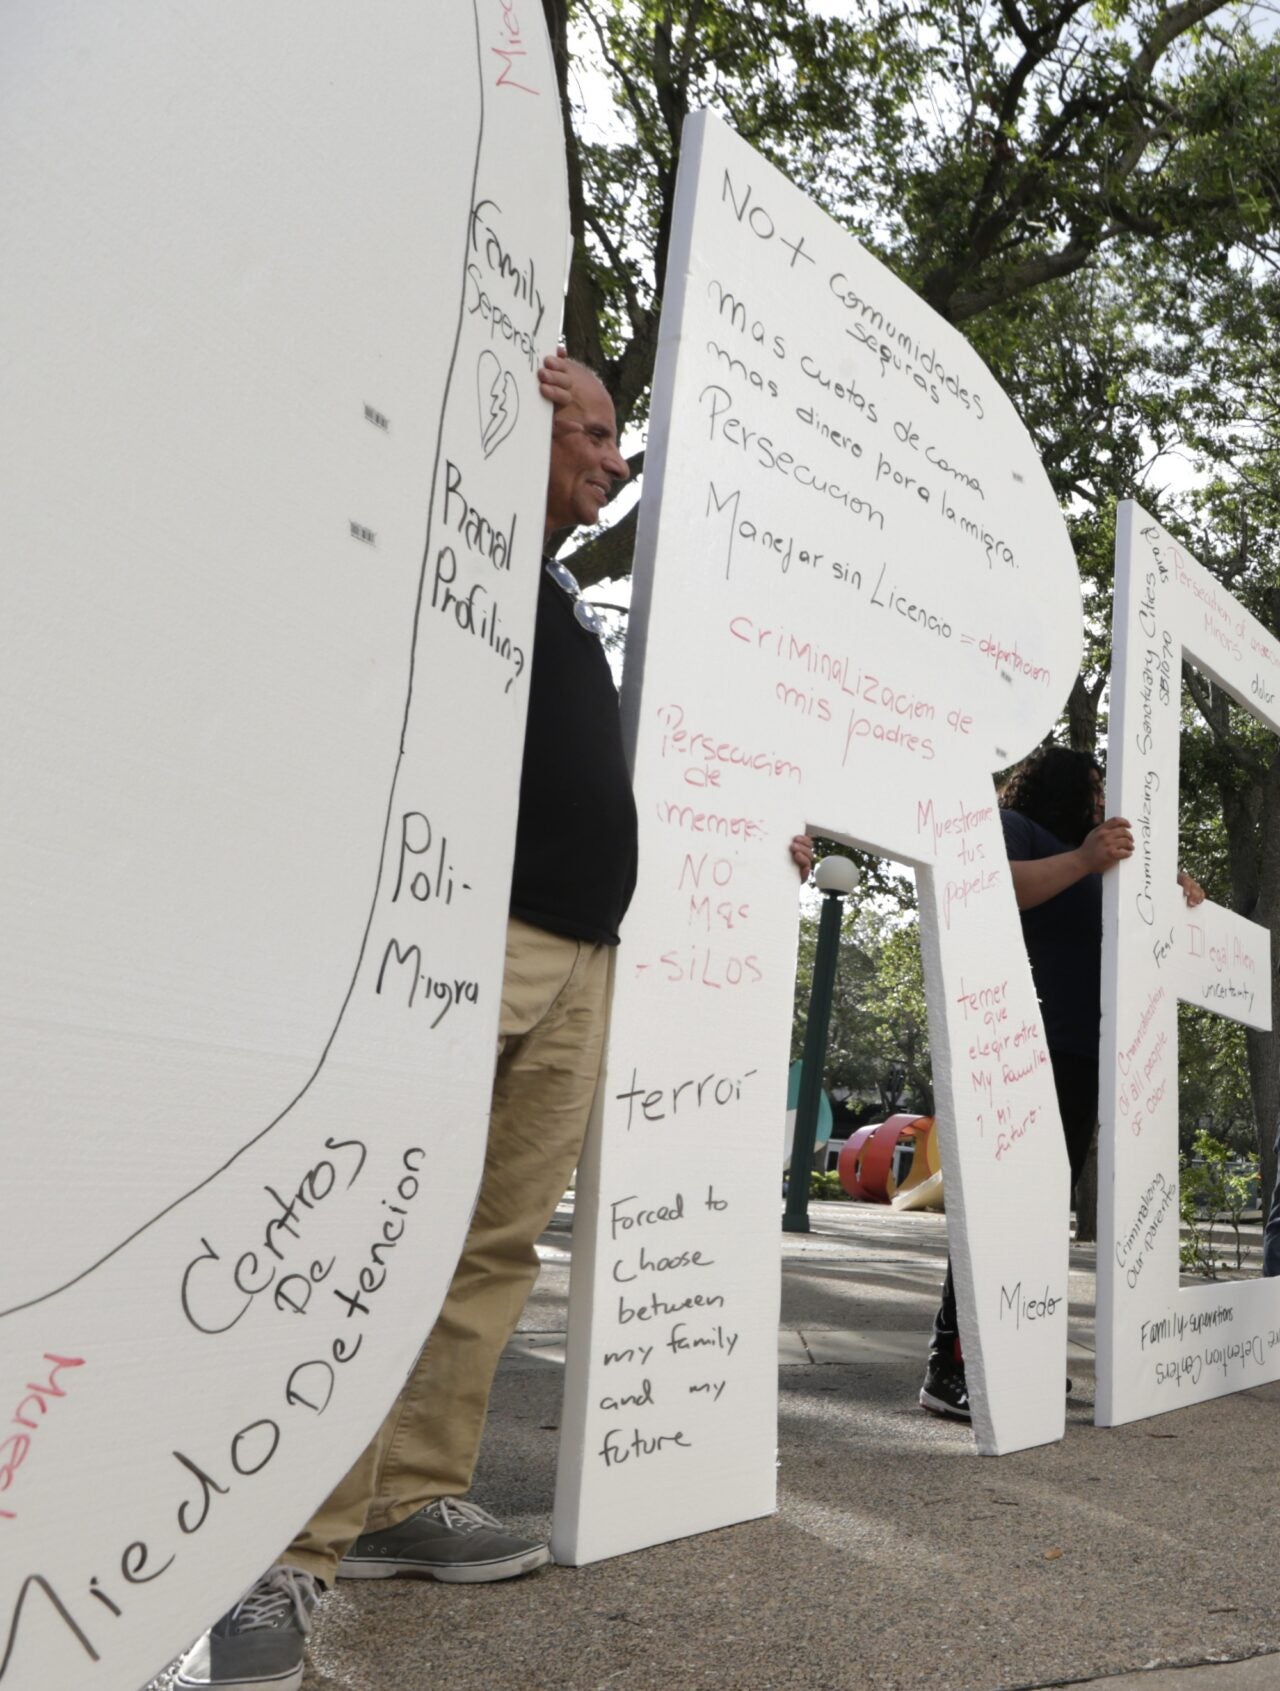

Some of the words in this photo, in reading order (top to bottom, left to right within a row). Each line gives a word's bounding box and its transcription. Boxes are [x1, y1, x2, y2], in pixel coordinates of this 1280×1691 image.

[443, 459, 519, 574] Racial
[832, 560, 863, 591] sin
[431, 546, 528, 694] Profiling
[776, 680, 832, 722] mis
[841, 707, 937, 768] padres
[946, 707, 975, 735] de
[957, 838, 986, 866] tus
[181, 1135, 368, 1335] Centros
[610, 1193, 684, 1240] Forced
[704, 1185, 729, 1212] to
[618, 1291, 725, 1326] between
[999, 1281, 1062, 1332] Miedo
[603, 1345, 654, 1368] my
[666, 1323, 739, 1358] family
[599, 1378, 655, 1411] and
[688, 1379, 727, 1402] my
[598, 1427, 693, 1469] future
